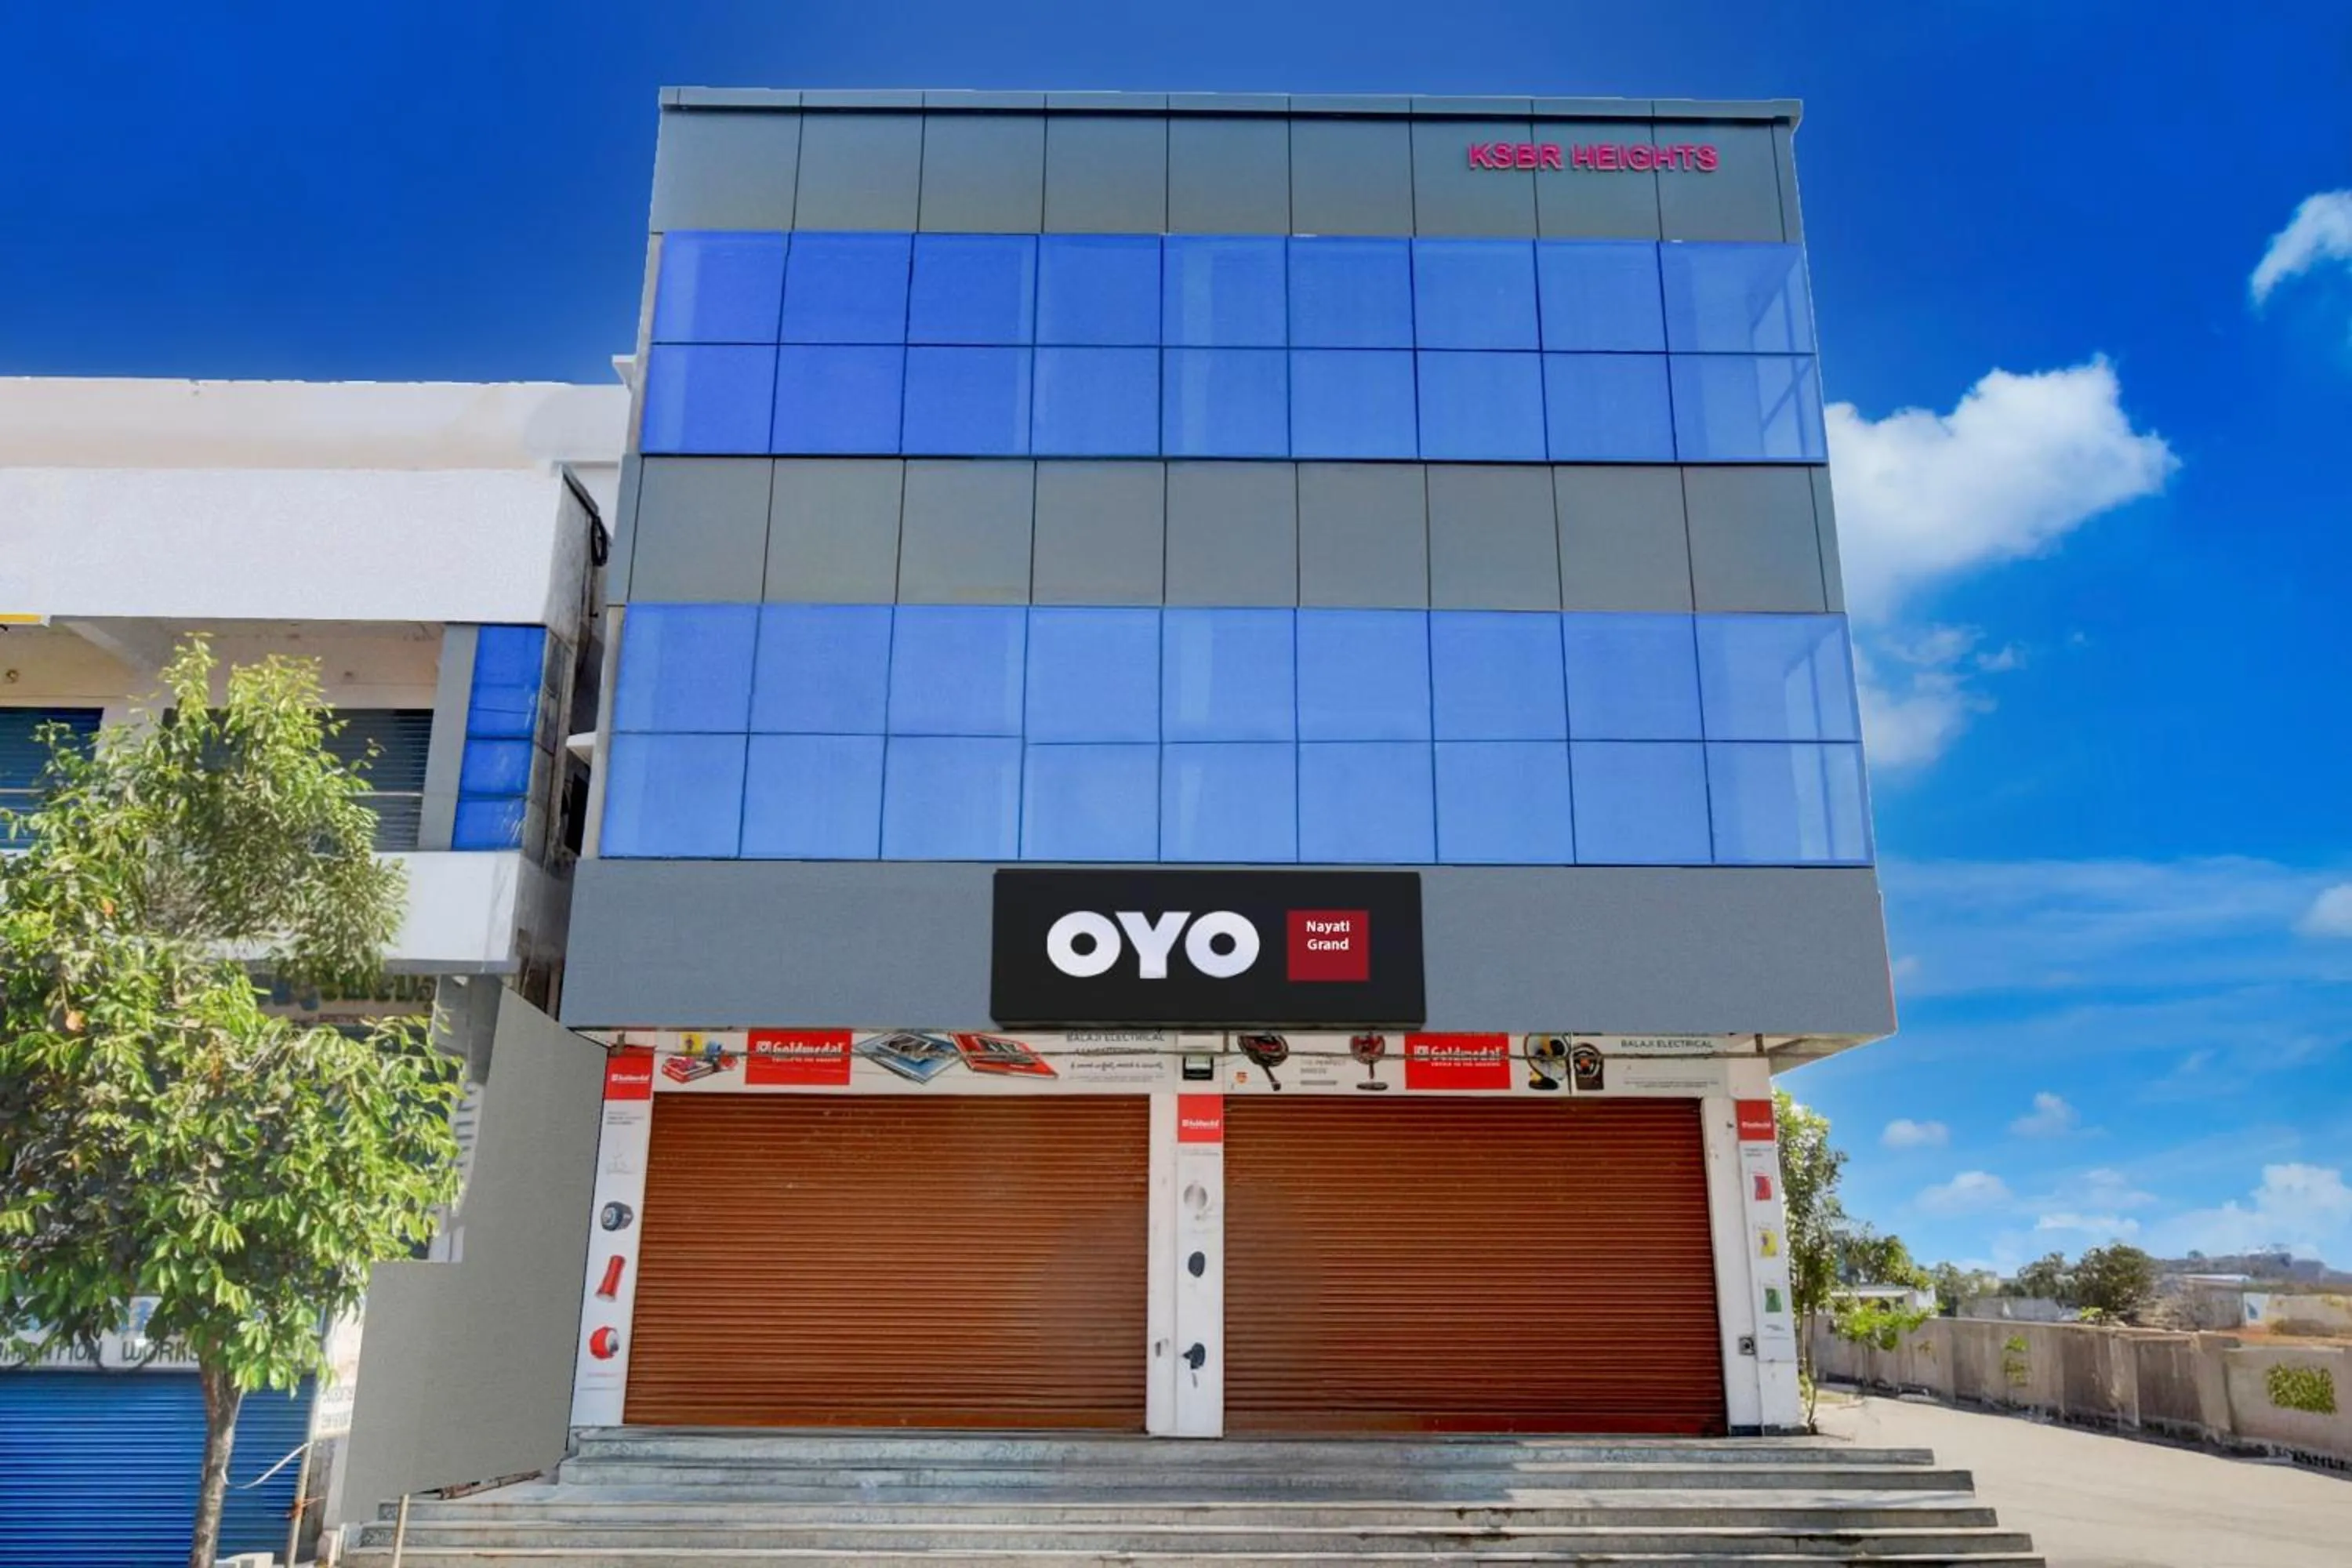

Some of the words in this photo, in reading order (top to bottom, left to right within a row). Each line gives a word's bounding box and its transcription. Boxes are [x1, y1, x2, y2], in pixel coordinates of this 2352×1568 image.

[1468, 143, 1563, 169] KSBR
[1571, 144, 1719, 171] HEIGHTS
[1306, 920, 1350, 935] Nayati
[1047, 910, 1260, 978] OYO
[1307, 938, 1349, 950] Grand
[1657, 1039, 1713, 1048] ELECTRICAL
